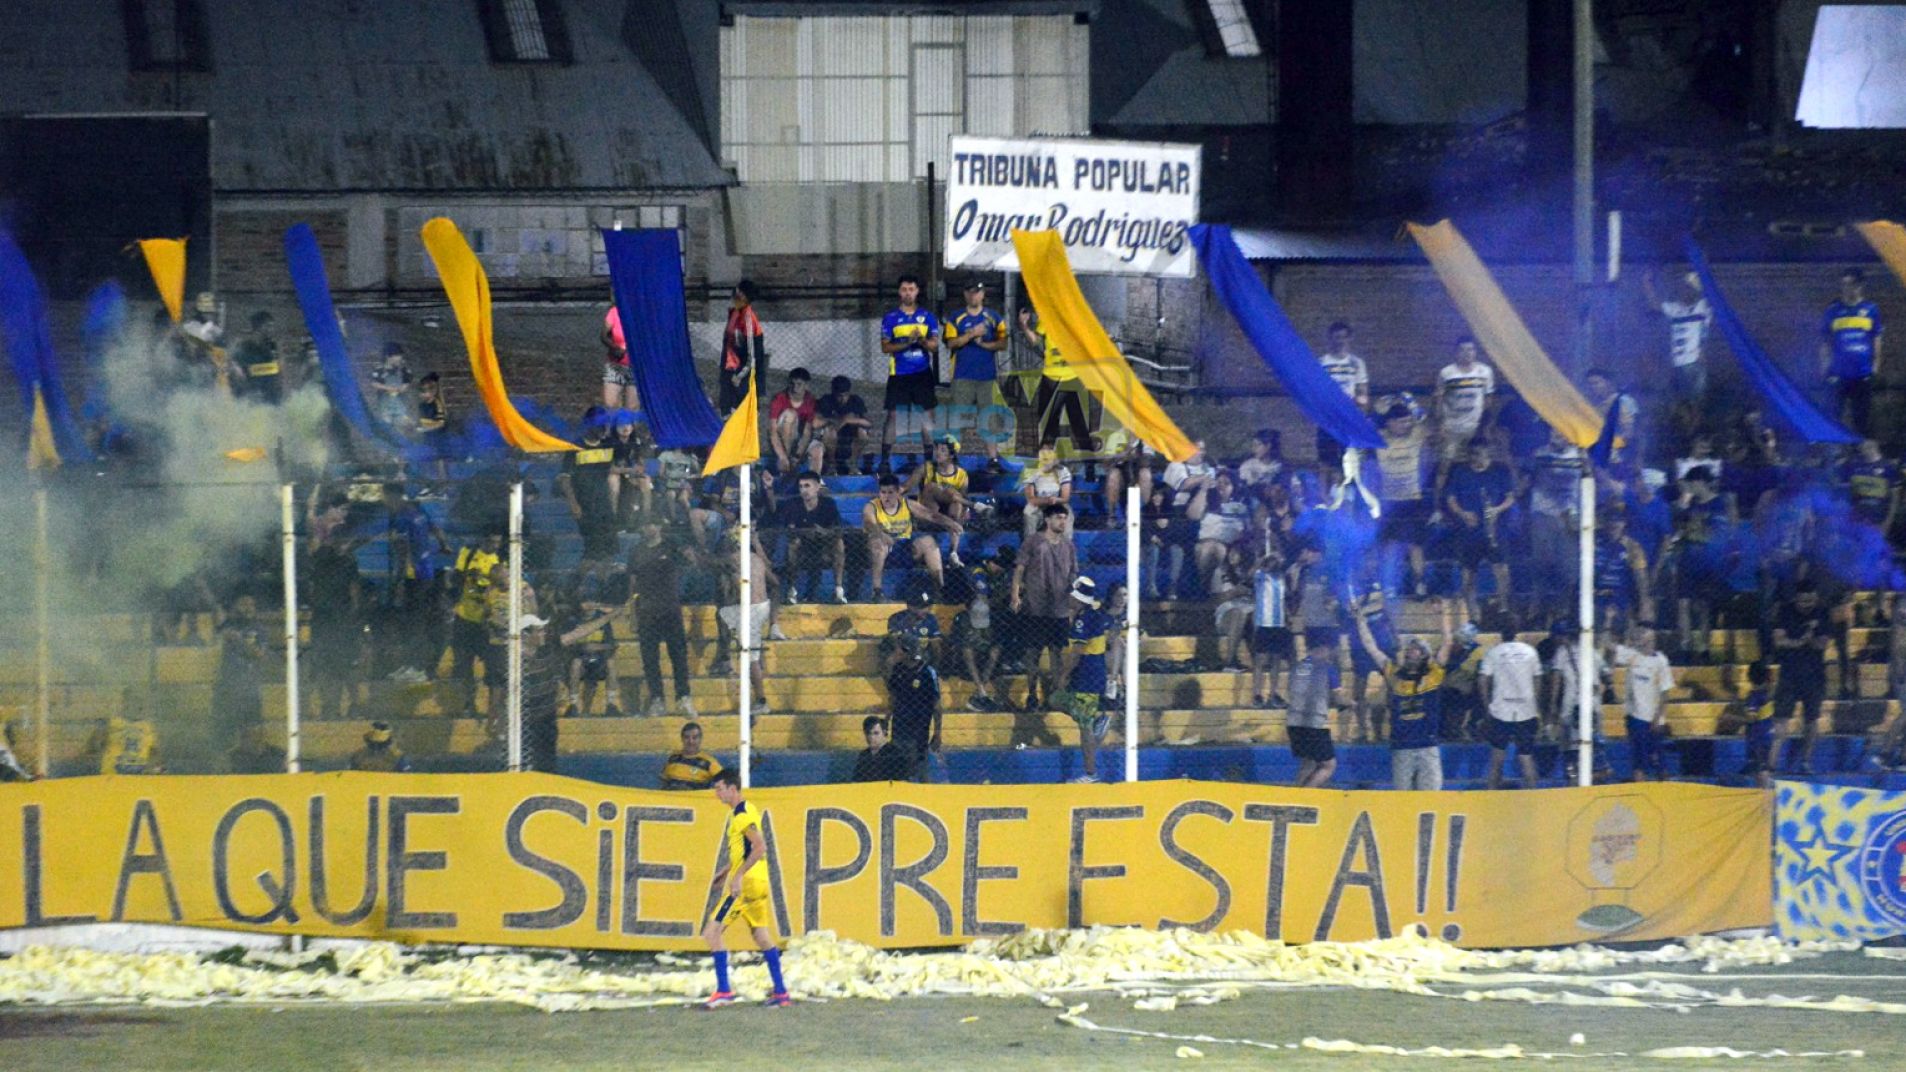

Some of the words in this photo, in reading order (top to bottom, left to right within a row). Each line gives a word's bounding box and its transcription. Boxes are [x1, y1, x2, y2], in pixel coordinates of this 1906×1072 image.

[954, 153, 1059, 189] TRIBUNA
[1073, 157, 1190, 195] POPULAR
[21, 798, 183, 927] LA
[212, 795, 460, 929] QUE
[1067, 799, 1466, 942] ESTA!!
